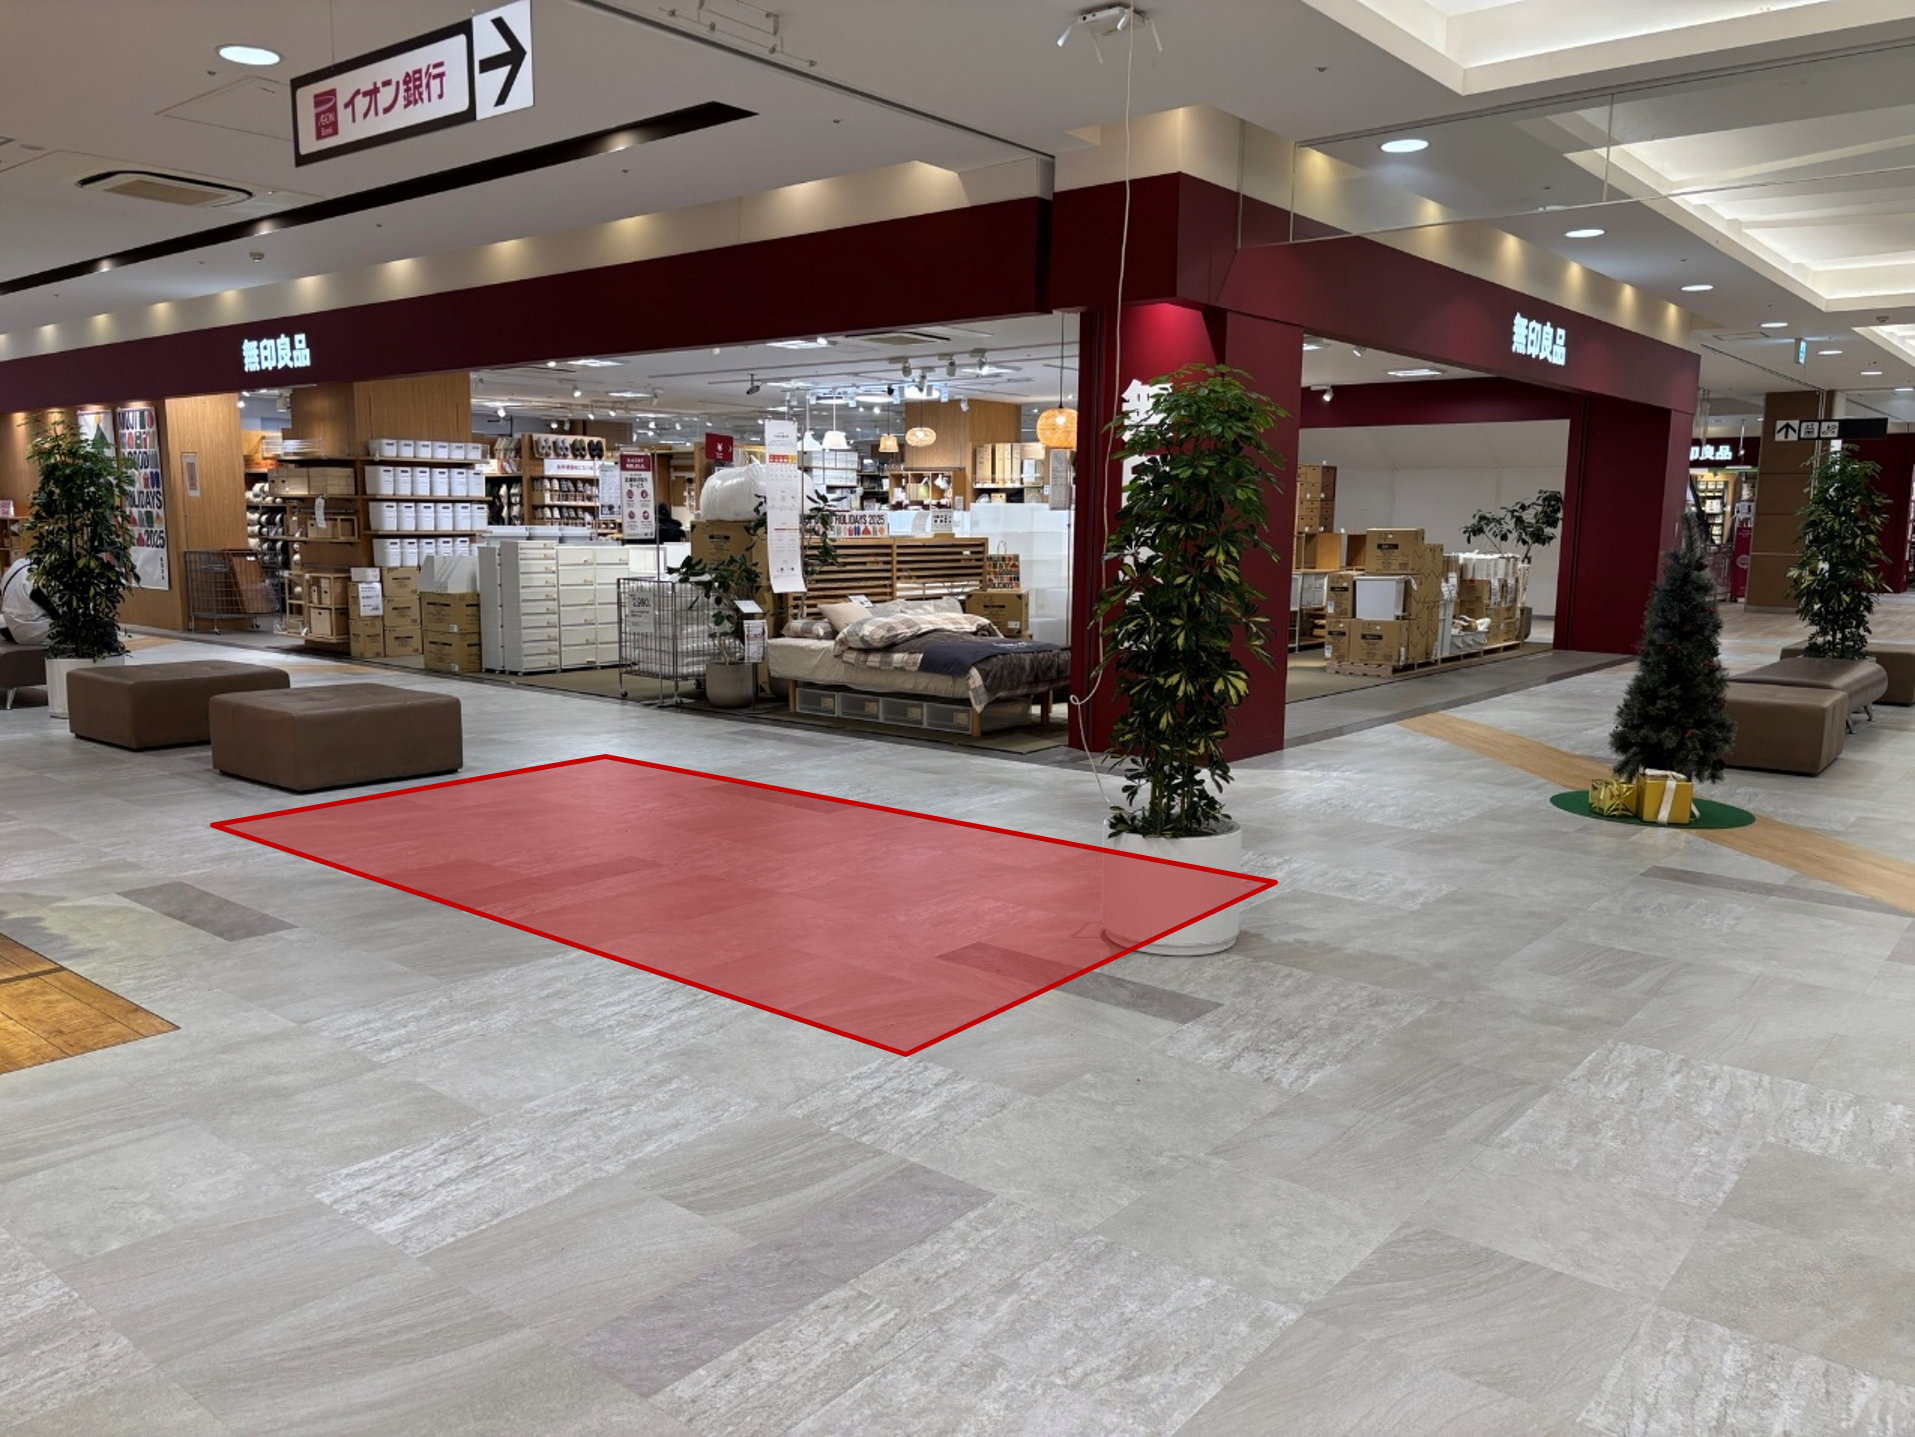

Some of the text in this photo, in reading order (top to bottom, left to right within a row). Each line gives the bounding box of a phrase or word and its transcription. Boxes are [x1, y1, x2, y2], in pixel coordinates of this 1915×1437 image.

[343, 61, 446, 124] イオン銀行
[241, 332, 311, 373] 無印良品
[1511, 311, 1566, 367] 無印良品
